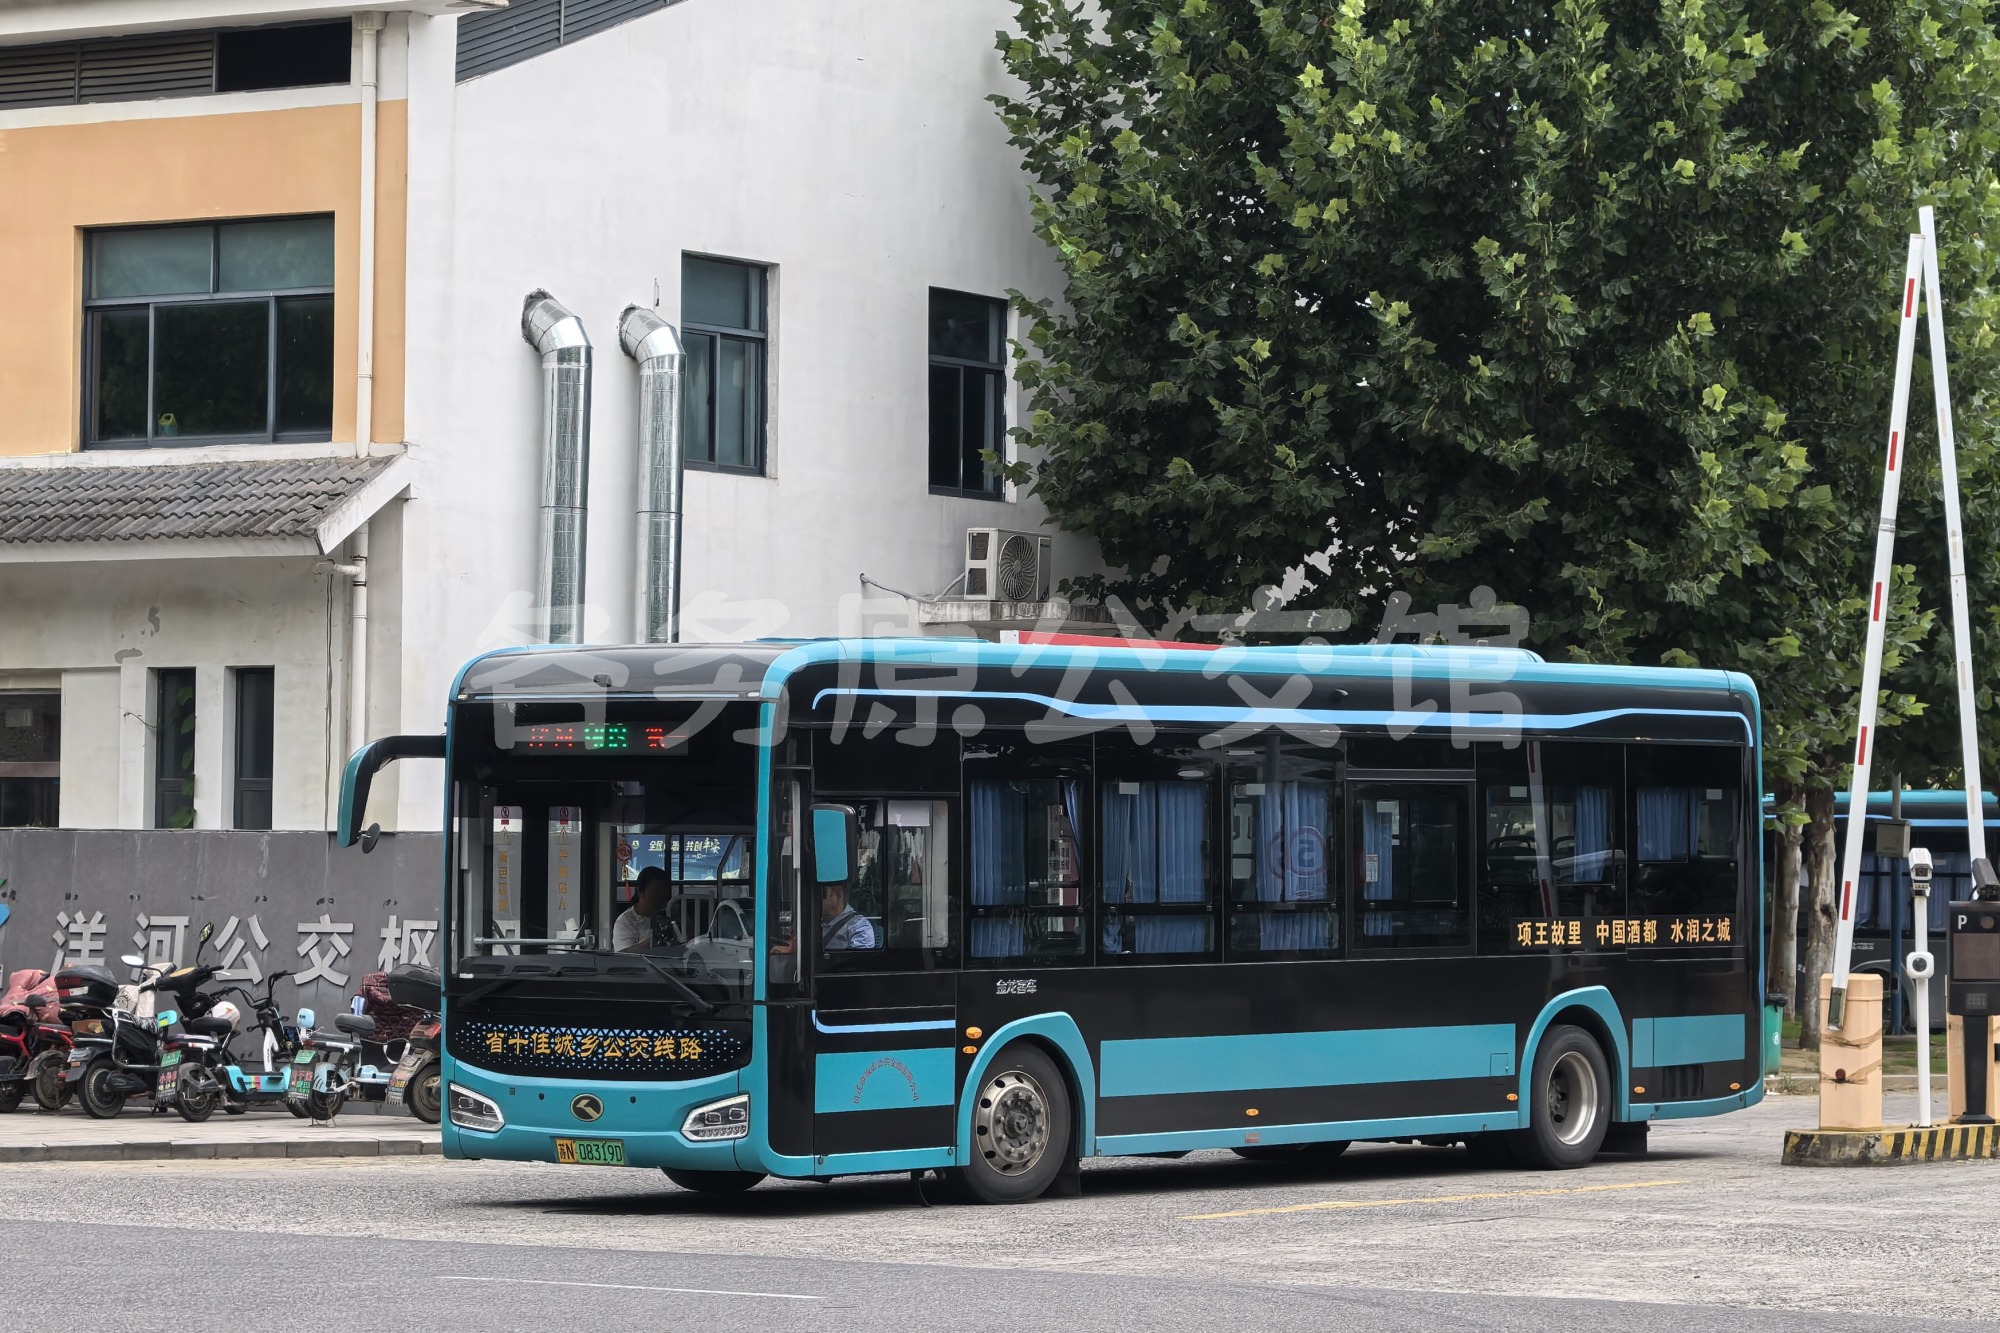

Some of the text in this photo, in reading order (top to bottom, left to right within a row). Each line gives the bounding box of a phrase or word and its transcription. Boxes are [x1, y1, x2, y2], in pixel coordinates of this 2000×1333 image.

[1517, 917, 1731, 946] 项王故里 中国酒都 水润之城
[1957, 914, 1968, 930] P
[996, 979, 1037, 994] 金龙客车
[485, 1031, 704, 1060] 省十佳城乡公交线路
